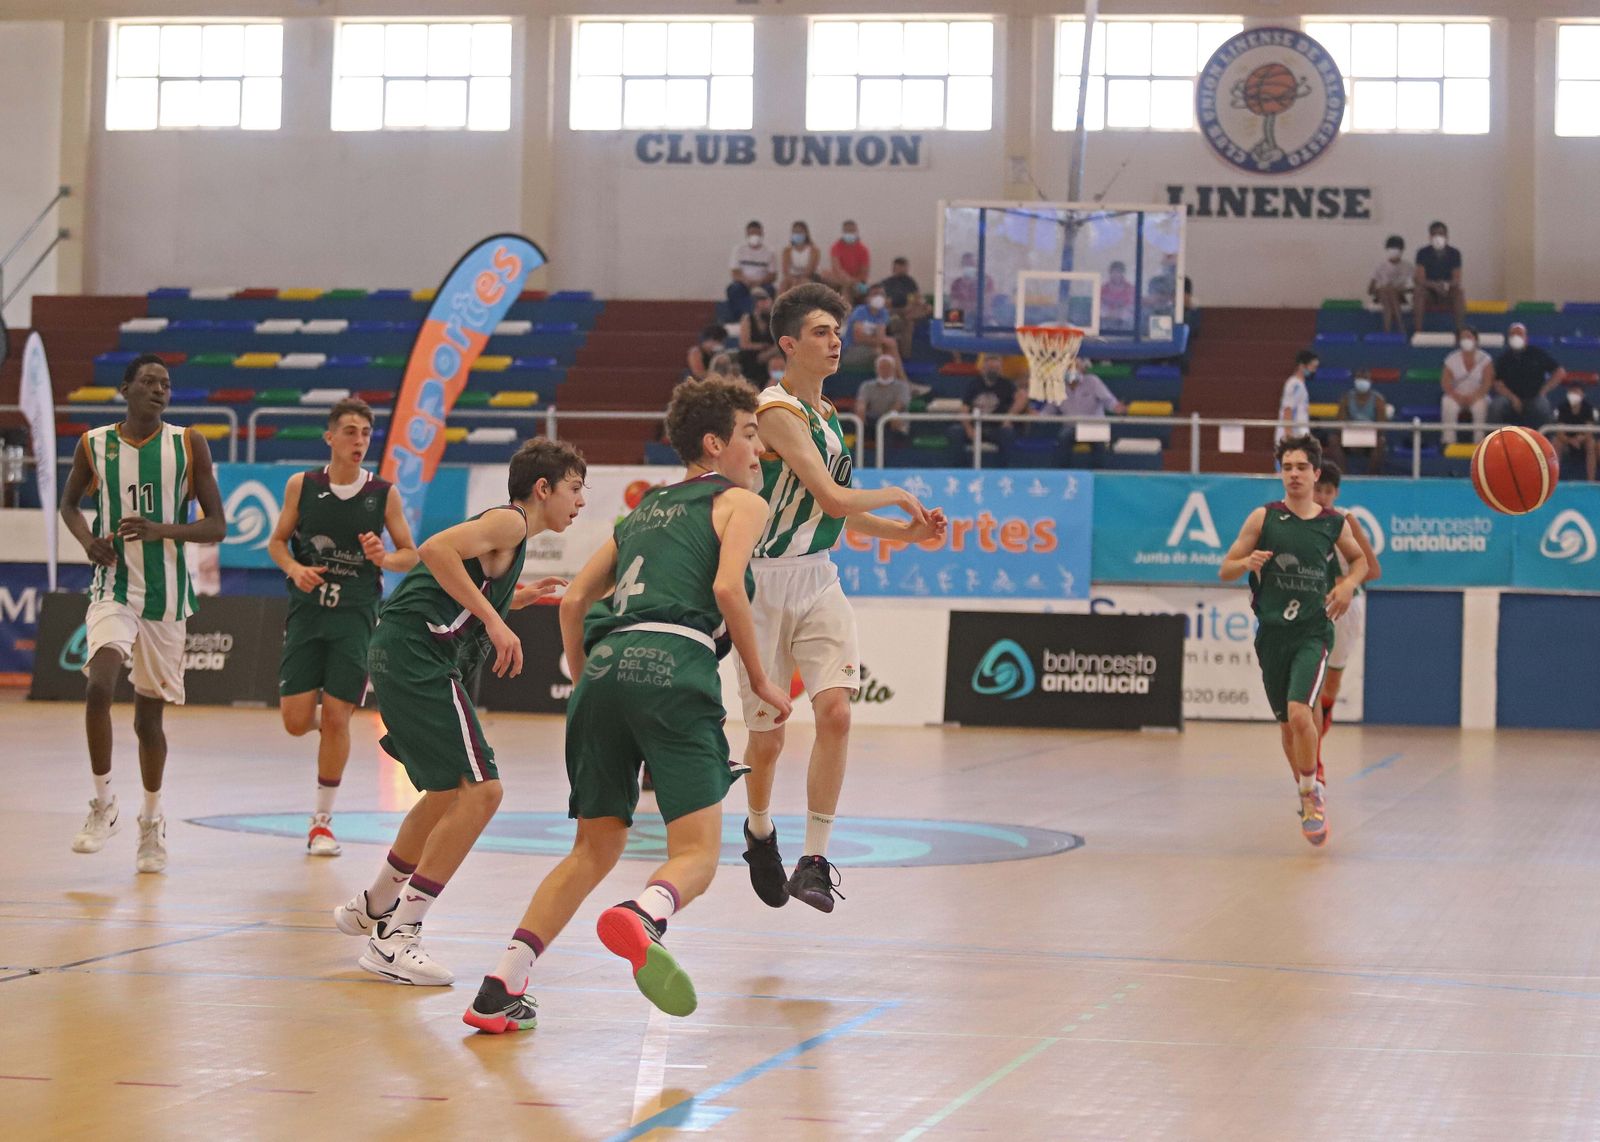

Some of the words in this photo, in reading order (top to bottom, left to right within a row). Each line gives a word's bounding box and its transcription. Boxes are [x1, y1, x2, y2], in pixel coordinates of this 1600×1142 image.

[1217, 30, 1294, 62] LINENSE
[1296, 40, 1321, 62] DE
[635, 134, 757, 164] CLUB
[771, 135, 923, 166] UNION
[1166, 186, 1372, 218] LINENSE
[127, 482, 154, 513] 11
[1391, 513, 1493, 534] baloncesto
[829, 511, 1058, 564] eportes
[1134, 551, 1171, 565] Junta
[1172, 551, 1187, 565] de
[319, 582, 341, 608] 13
[613, 555, 646, 617] 4
[1283, 599, 1301, 621] 8
[618, 659, 644, 671] DEL
[647, 661, 674, 678] SOL
[623, 646, 676, 667] COSTA
[1043, 648, 1157, 674] baloncesto
[617, 670, 673, 688] MÁLAGA
